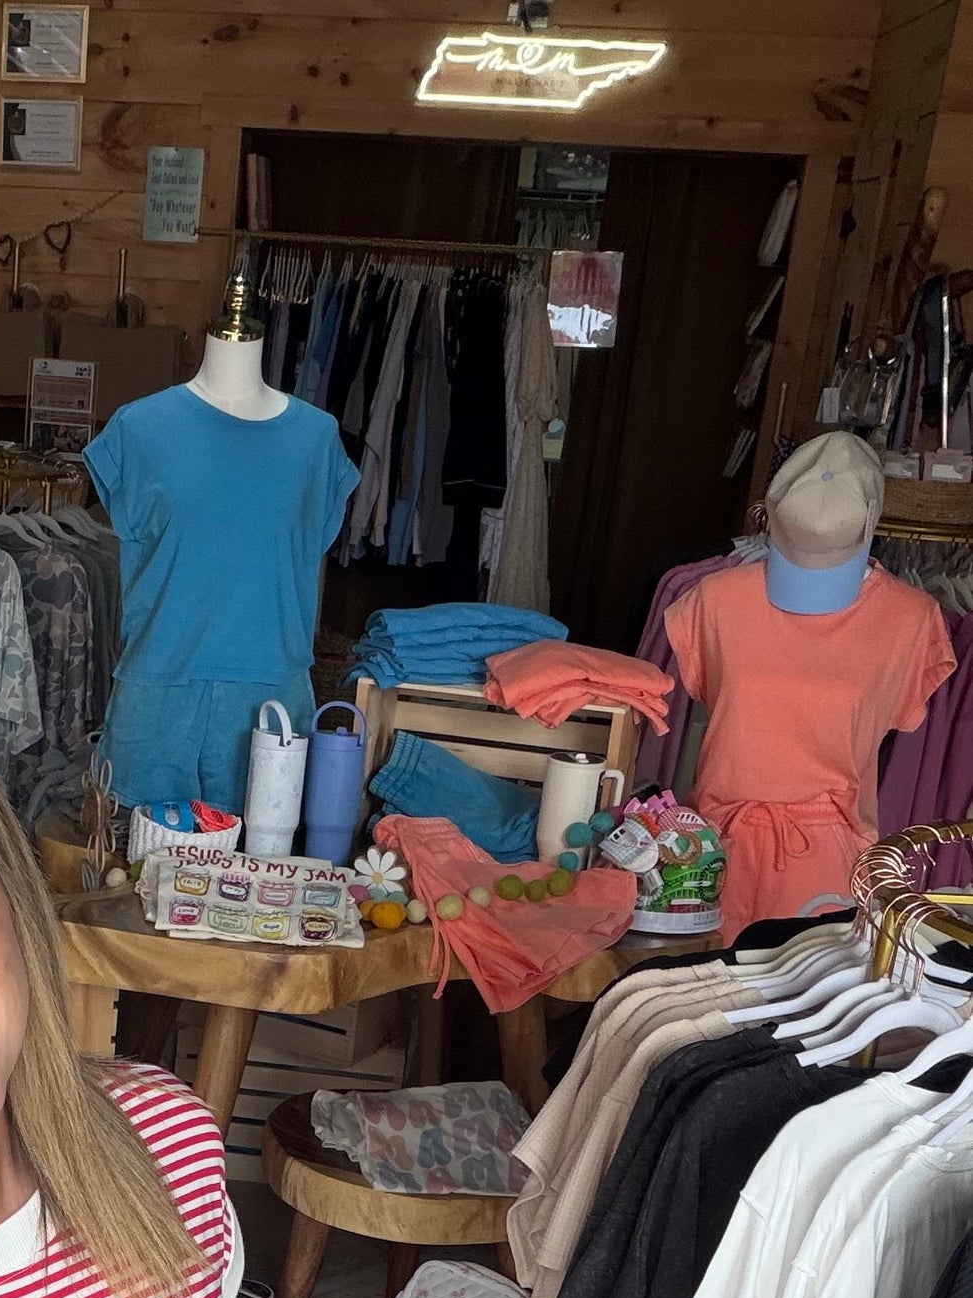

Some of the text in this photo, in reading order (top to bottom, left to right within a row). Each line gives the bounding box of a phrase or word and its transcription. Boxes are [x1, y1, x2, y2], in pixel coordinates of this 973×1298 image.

[240, 857, 260, 873] IS
[266, 863, 299, 880] MY
[303, 869, 347, 884] JAM
